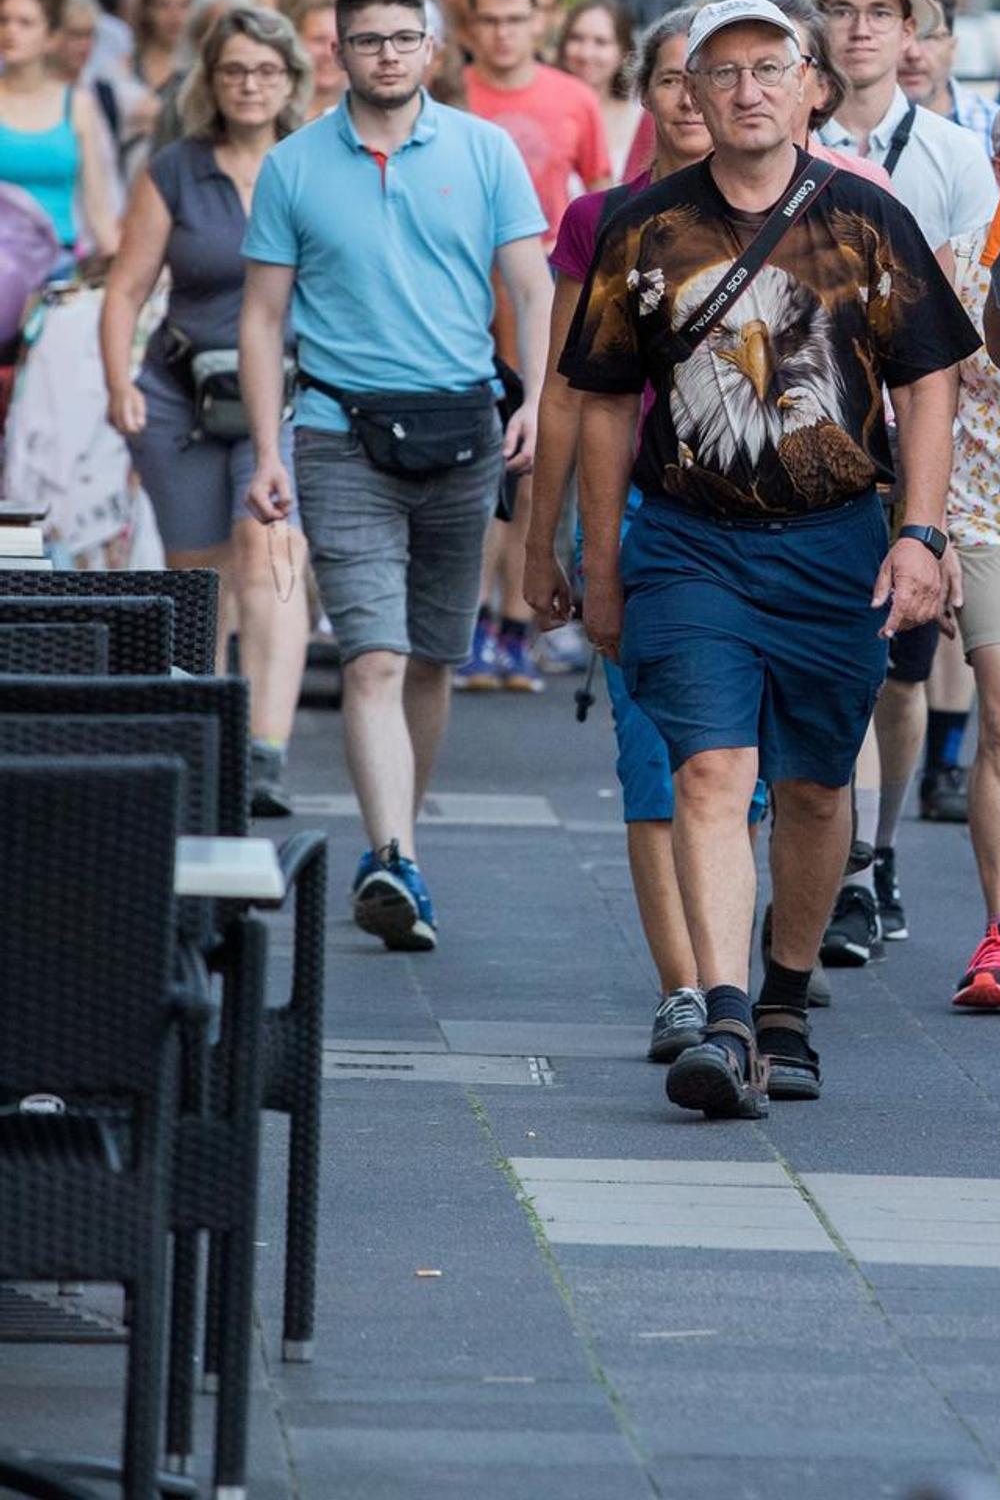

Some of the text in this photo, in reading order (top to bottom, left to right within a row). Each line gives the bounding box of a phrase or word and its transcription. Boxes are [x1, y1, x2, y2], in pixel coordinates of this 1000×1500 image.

[782, 179, 816, 217] Canon
[689, 266, 748, 333] EOS DIGITAL
